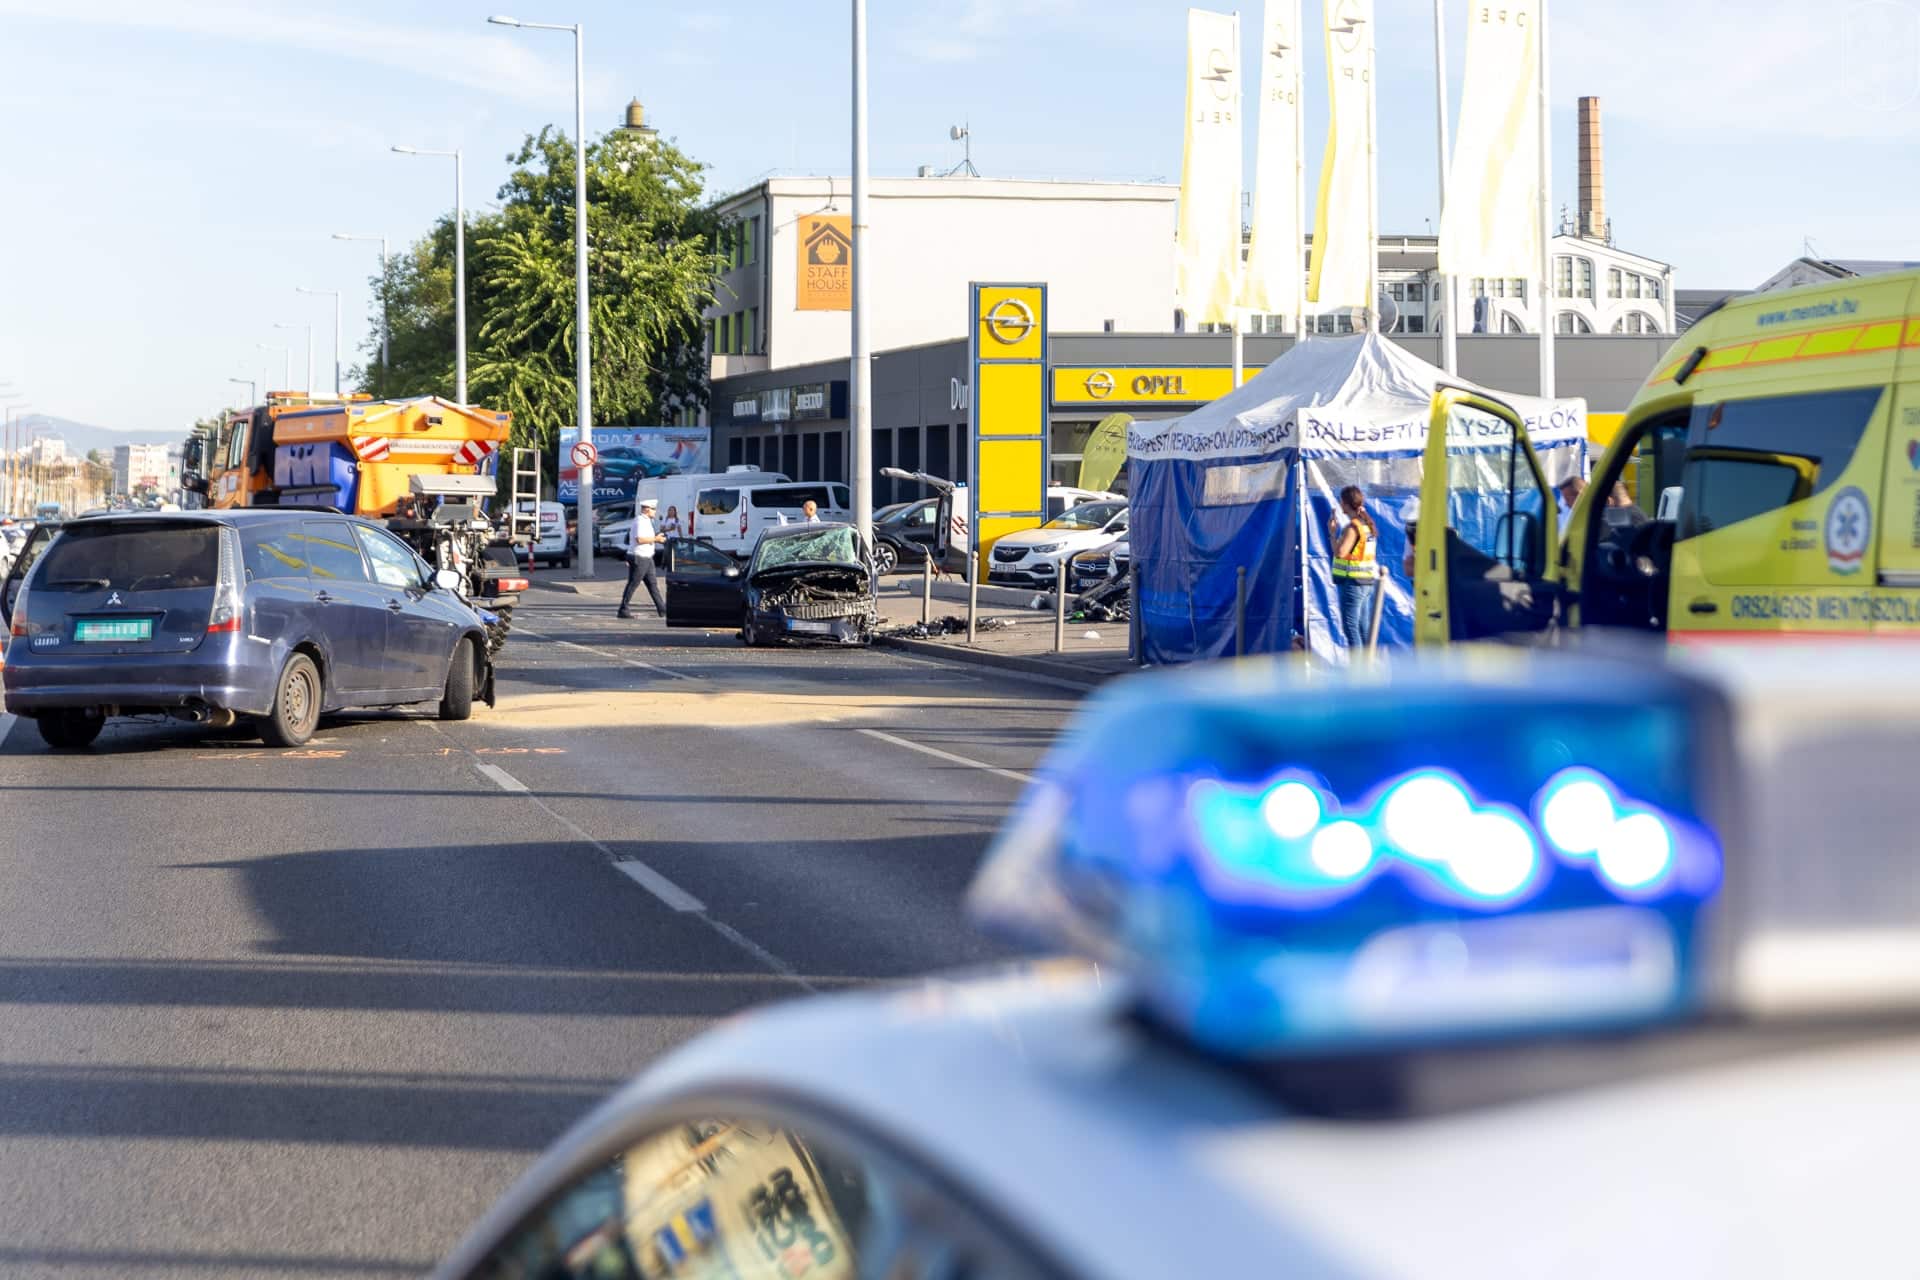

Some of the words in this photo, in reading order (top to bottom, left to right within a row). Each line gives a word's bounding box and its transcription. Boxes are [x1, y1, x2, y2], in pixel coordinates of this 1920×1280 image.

[807, 266, 849, 278] STAFF
[807, 279, 849, 290] HOUSE
[1132, 375, 1188, 395] OPEL
[1306, 418, 1413, 442] BALESETI
[591, 487, 625, 496] XTRA
[1731, 591, 1812, 619] ORSZÁGOS
